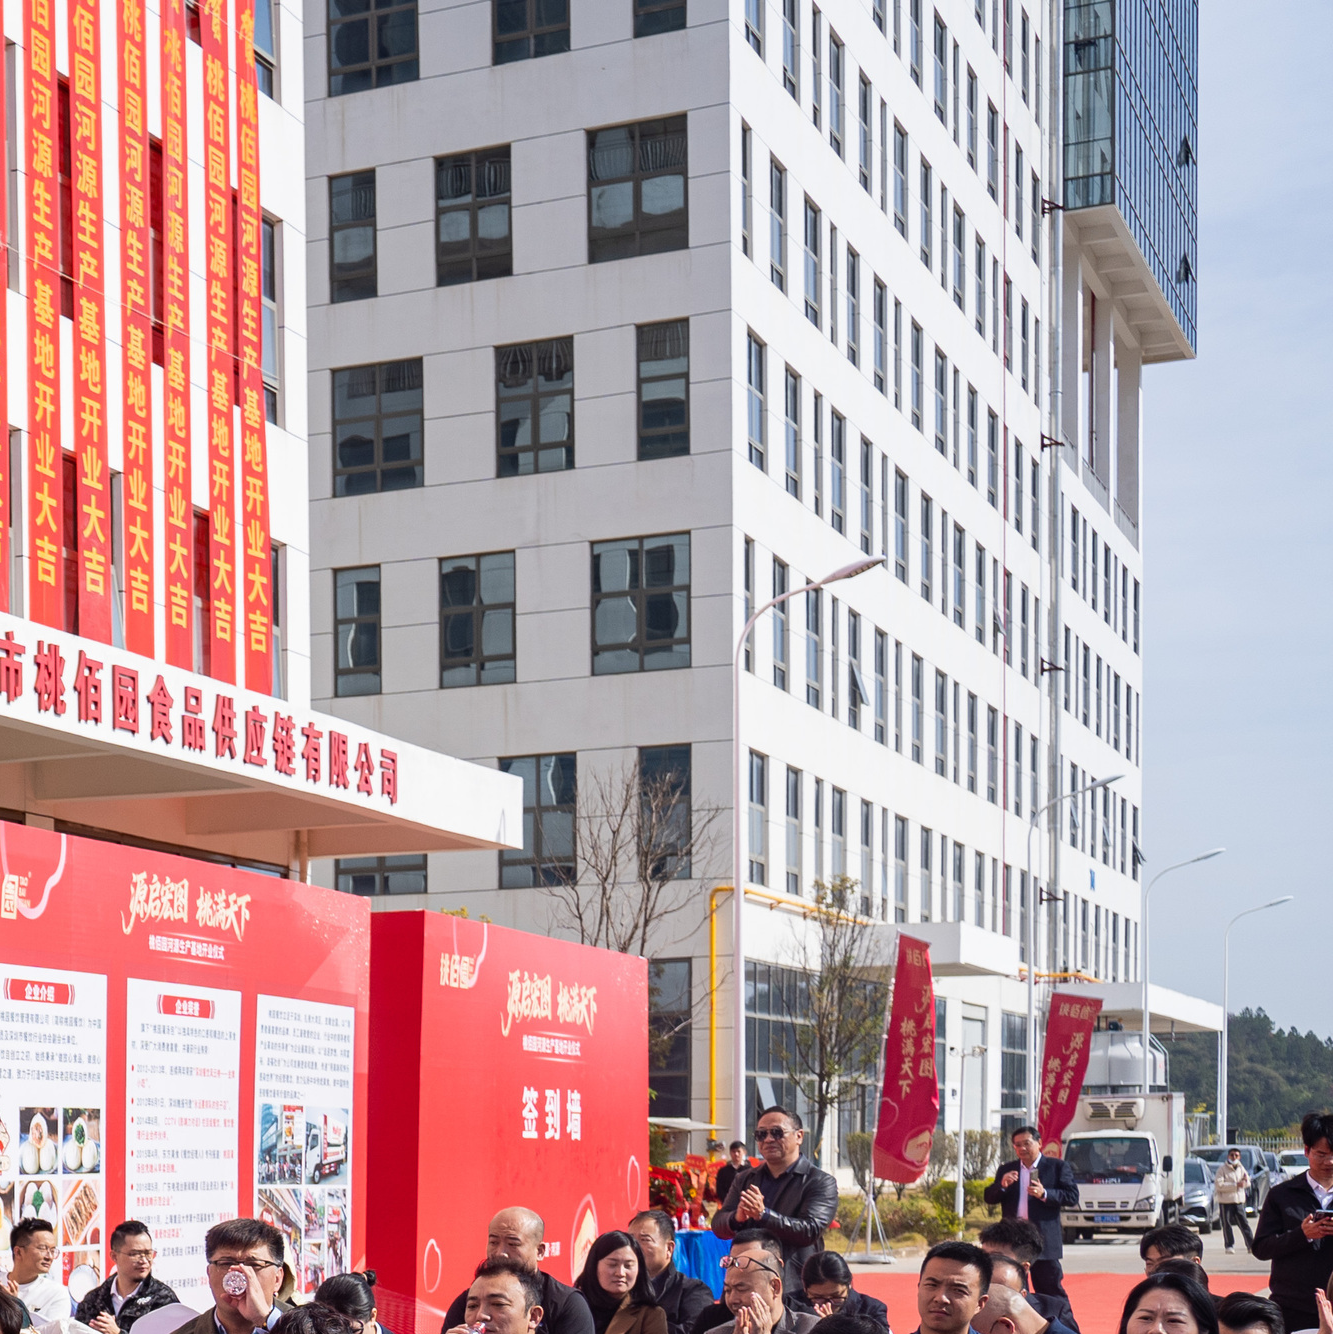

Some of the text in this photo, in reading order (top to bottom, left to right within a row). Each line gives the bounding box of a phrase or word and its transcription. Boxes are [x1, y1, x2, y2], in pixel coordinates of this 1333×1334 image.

[72, 0, 107, 595] 佰园河源生产基地开业大吉
[163, 0, 190, 629] 桃佰园河源生产基地开业大吉
[120, 871, 252, 942] 源启宏图 桃满天下
[148, 934, 226, 961] 桃佰园河源生产基地开业仪式
[500, 968, 598, 1037] 源启宏图 桃满天下
[898, 1016, 918, 1101] 桃满天下
[522, 1086, 582, 1141] 签到墙
